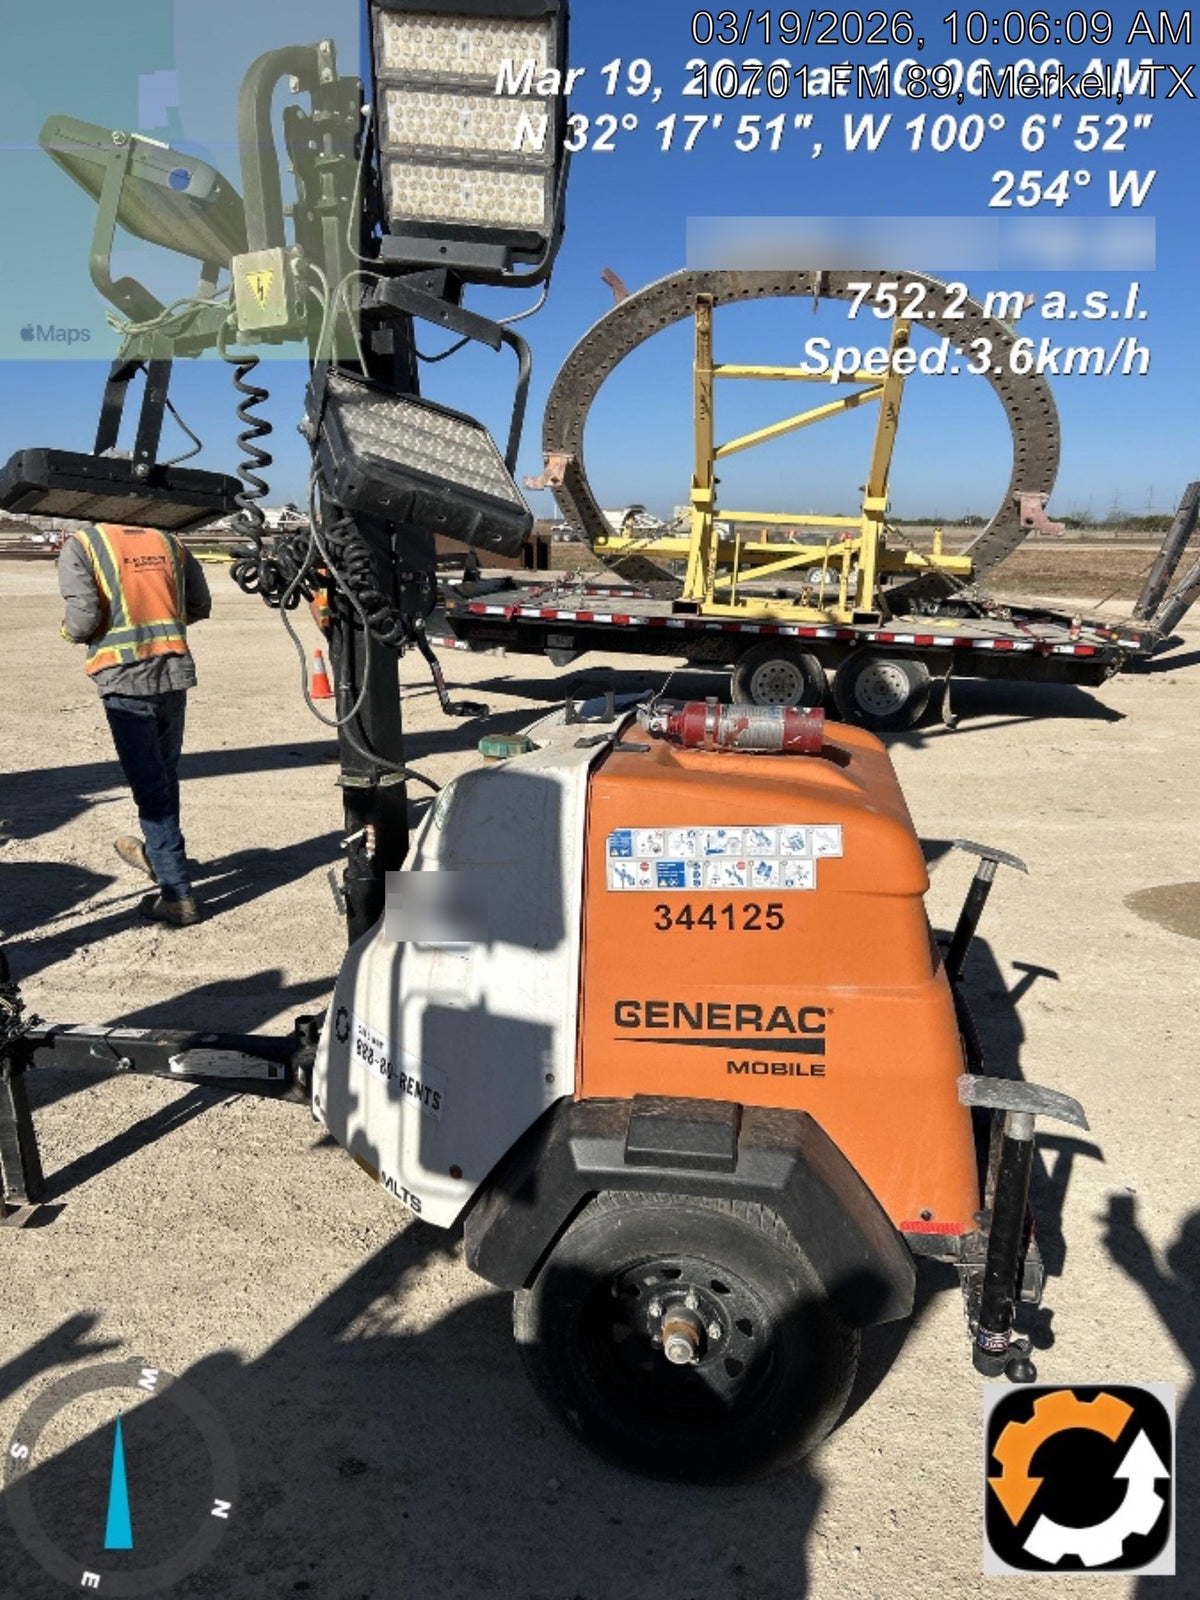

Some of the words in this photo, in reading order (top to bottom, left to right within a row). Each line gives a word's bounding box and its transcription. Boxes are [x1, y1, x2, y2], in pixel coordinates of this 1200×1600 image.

[653, 902, 785, 931] 344125
[613, 1000, 827, 1034] GENERAC
[726, 1060, 826, 1077] MOBILE
